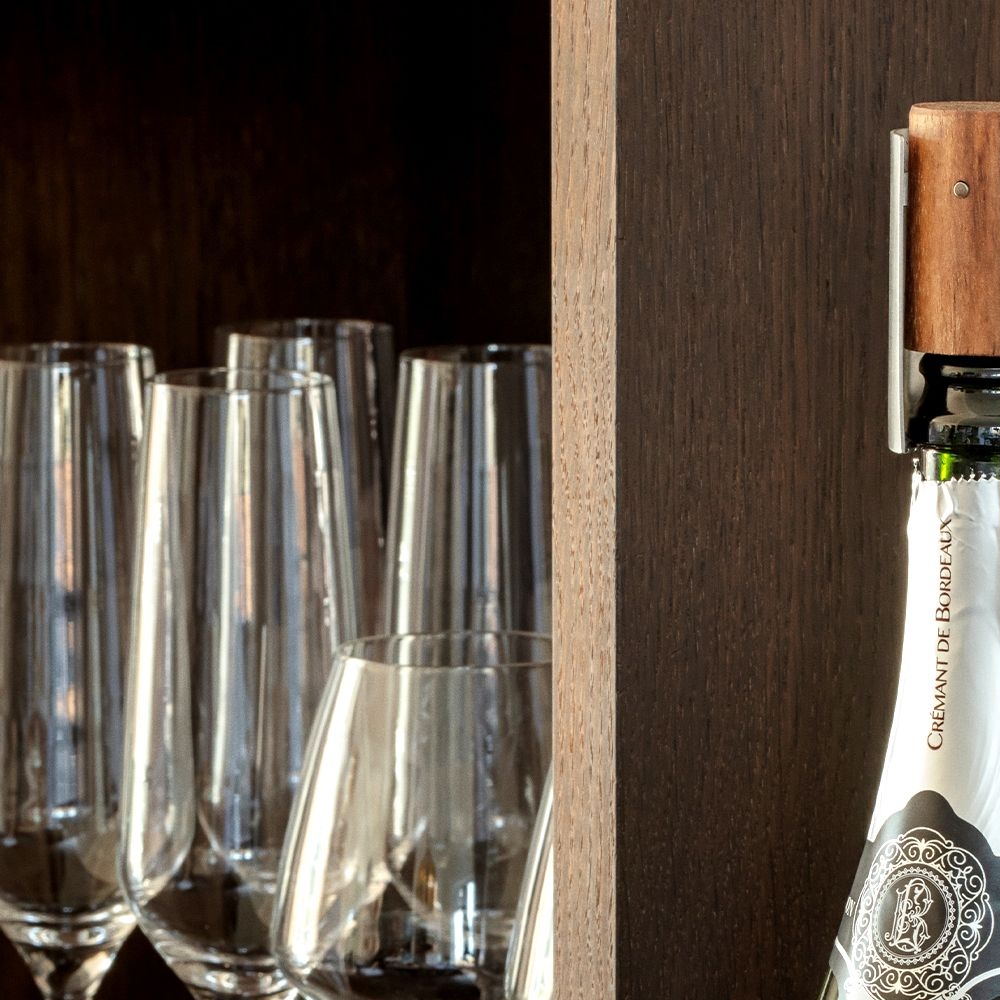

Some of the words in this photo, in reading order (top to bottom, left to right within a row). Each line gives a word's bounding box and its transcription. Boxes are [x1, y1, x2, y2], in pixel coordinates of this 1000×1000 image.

[935, 518, 952, 623] BORDEAUX
[936, 627, 951, 653] DE
[926, 657, 949, 751] CRÉMANT
